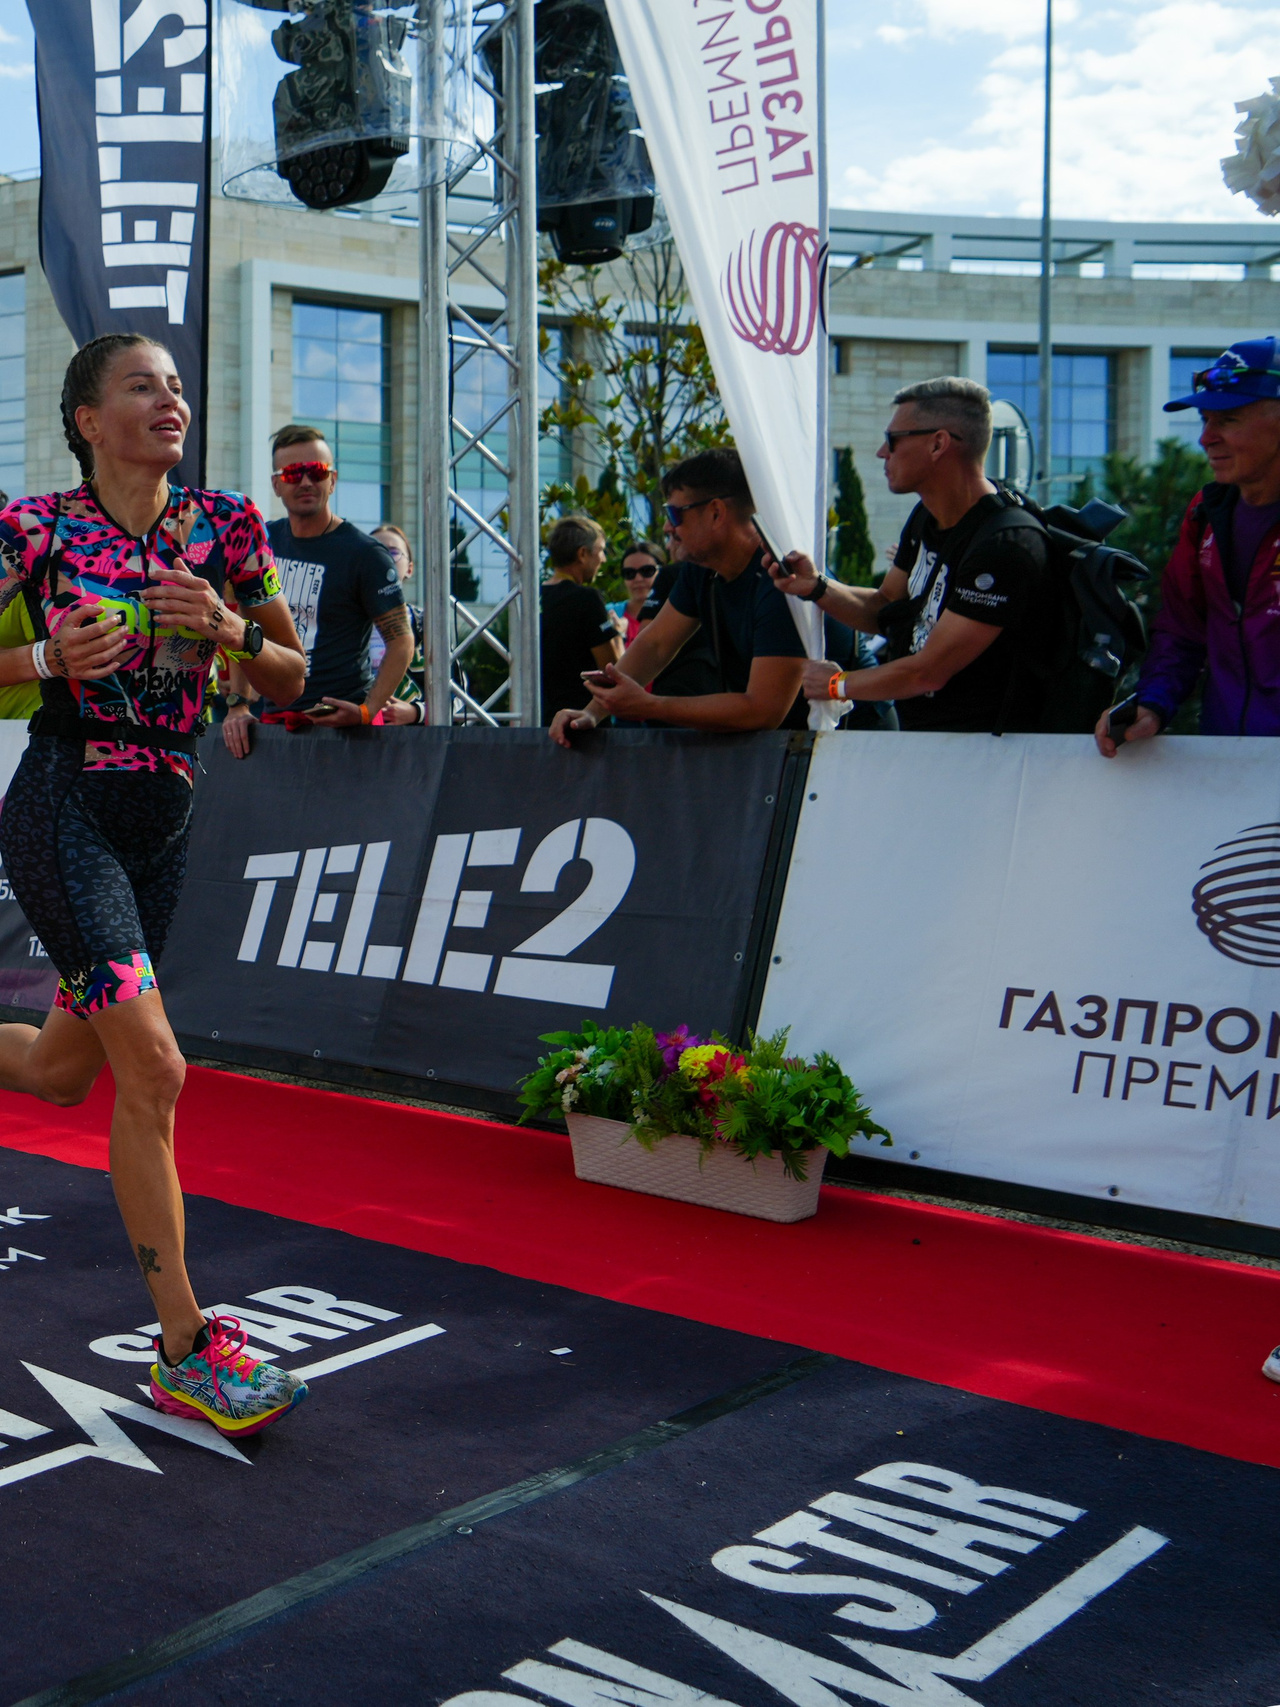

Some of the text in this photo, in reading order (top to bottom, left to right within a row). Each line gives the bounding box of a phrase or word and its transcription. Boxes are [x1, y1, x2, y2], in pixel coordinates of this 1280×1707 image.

[235, 815, 638, 1011] TELE2
[998, 986, 1280, 1060] ГАЗПРО
[711, 1460, 1088, 1633] STAR
